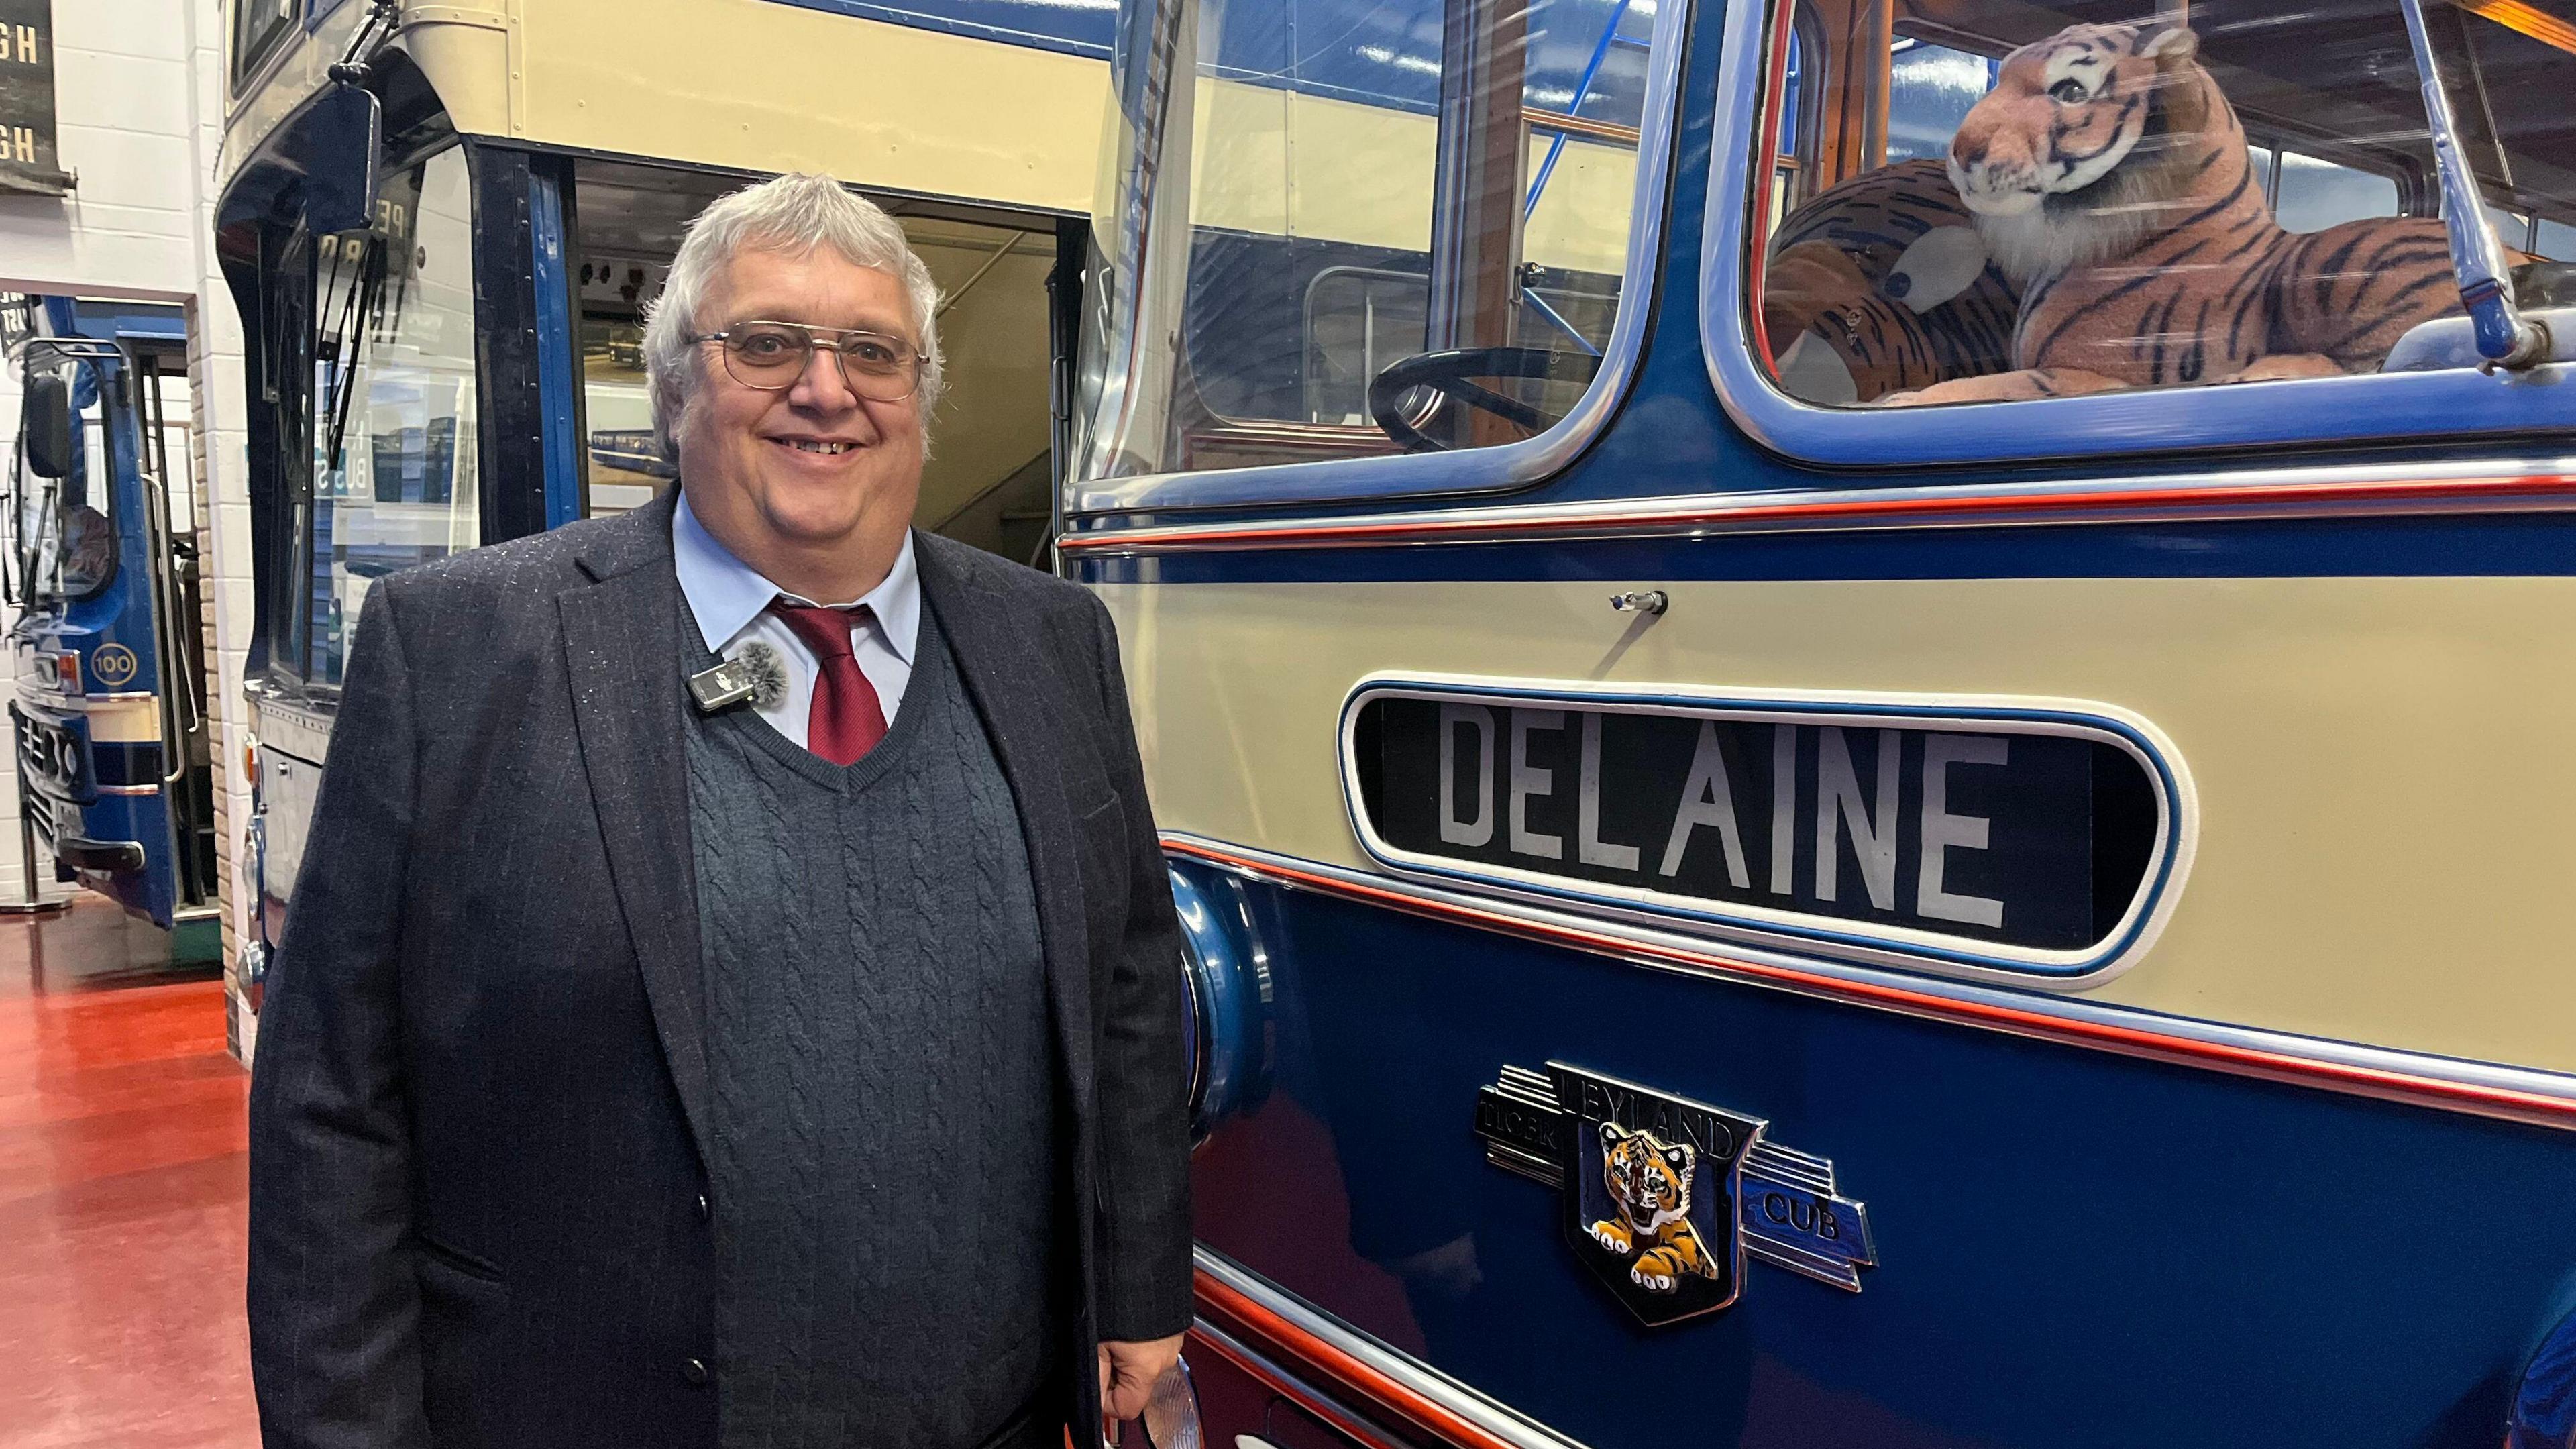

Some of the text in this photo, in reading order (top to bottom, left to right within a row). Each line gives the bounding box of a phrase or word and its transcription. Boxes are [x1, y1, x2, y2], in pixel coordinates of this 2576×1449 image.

[95, 655, 131, 673] 100
[1440, 702, 2010, 930] DELAINE
[1480, 1101, 1558, 1151] TIGER
[1556, 1071, 1736, 1160] LEYLAND
[1763, 1192, 1839, 1241] CUB
